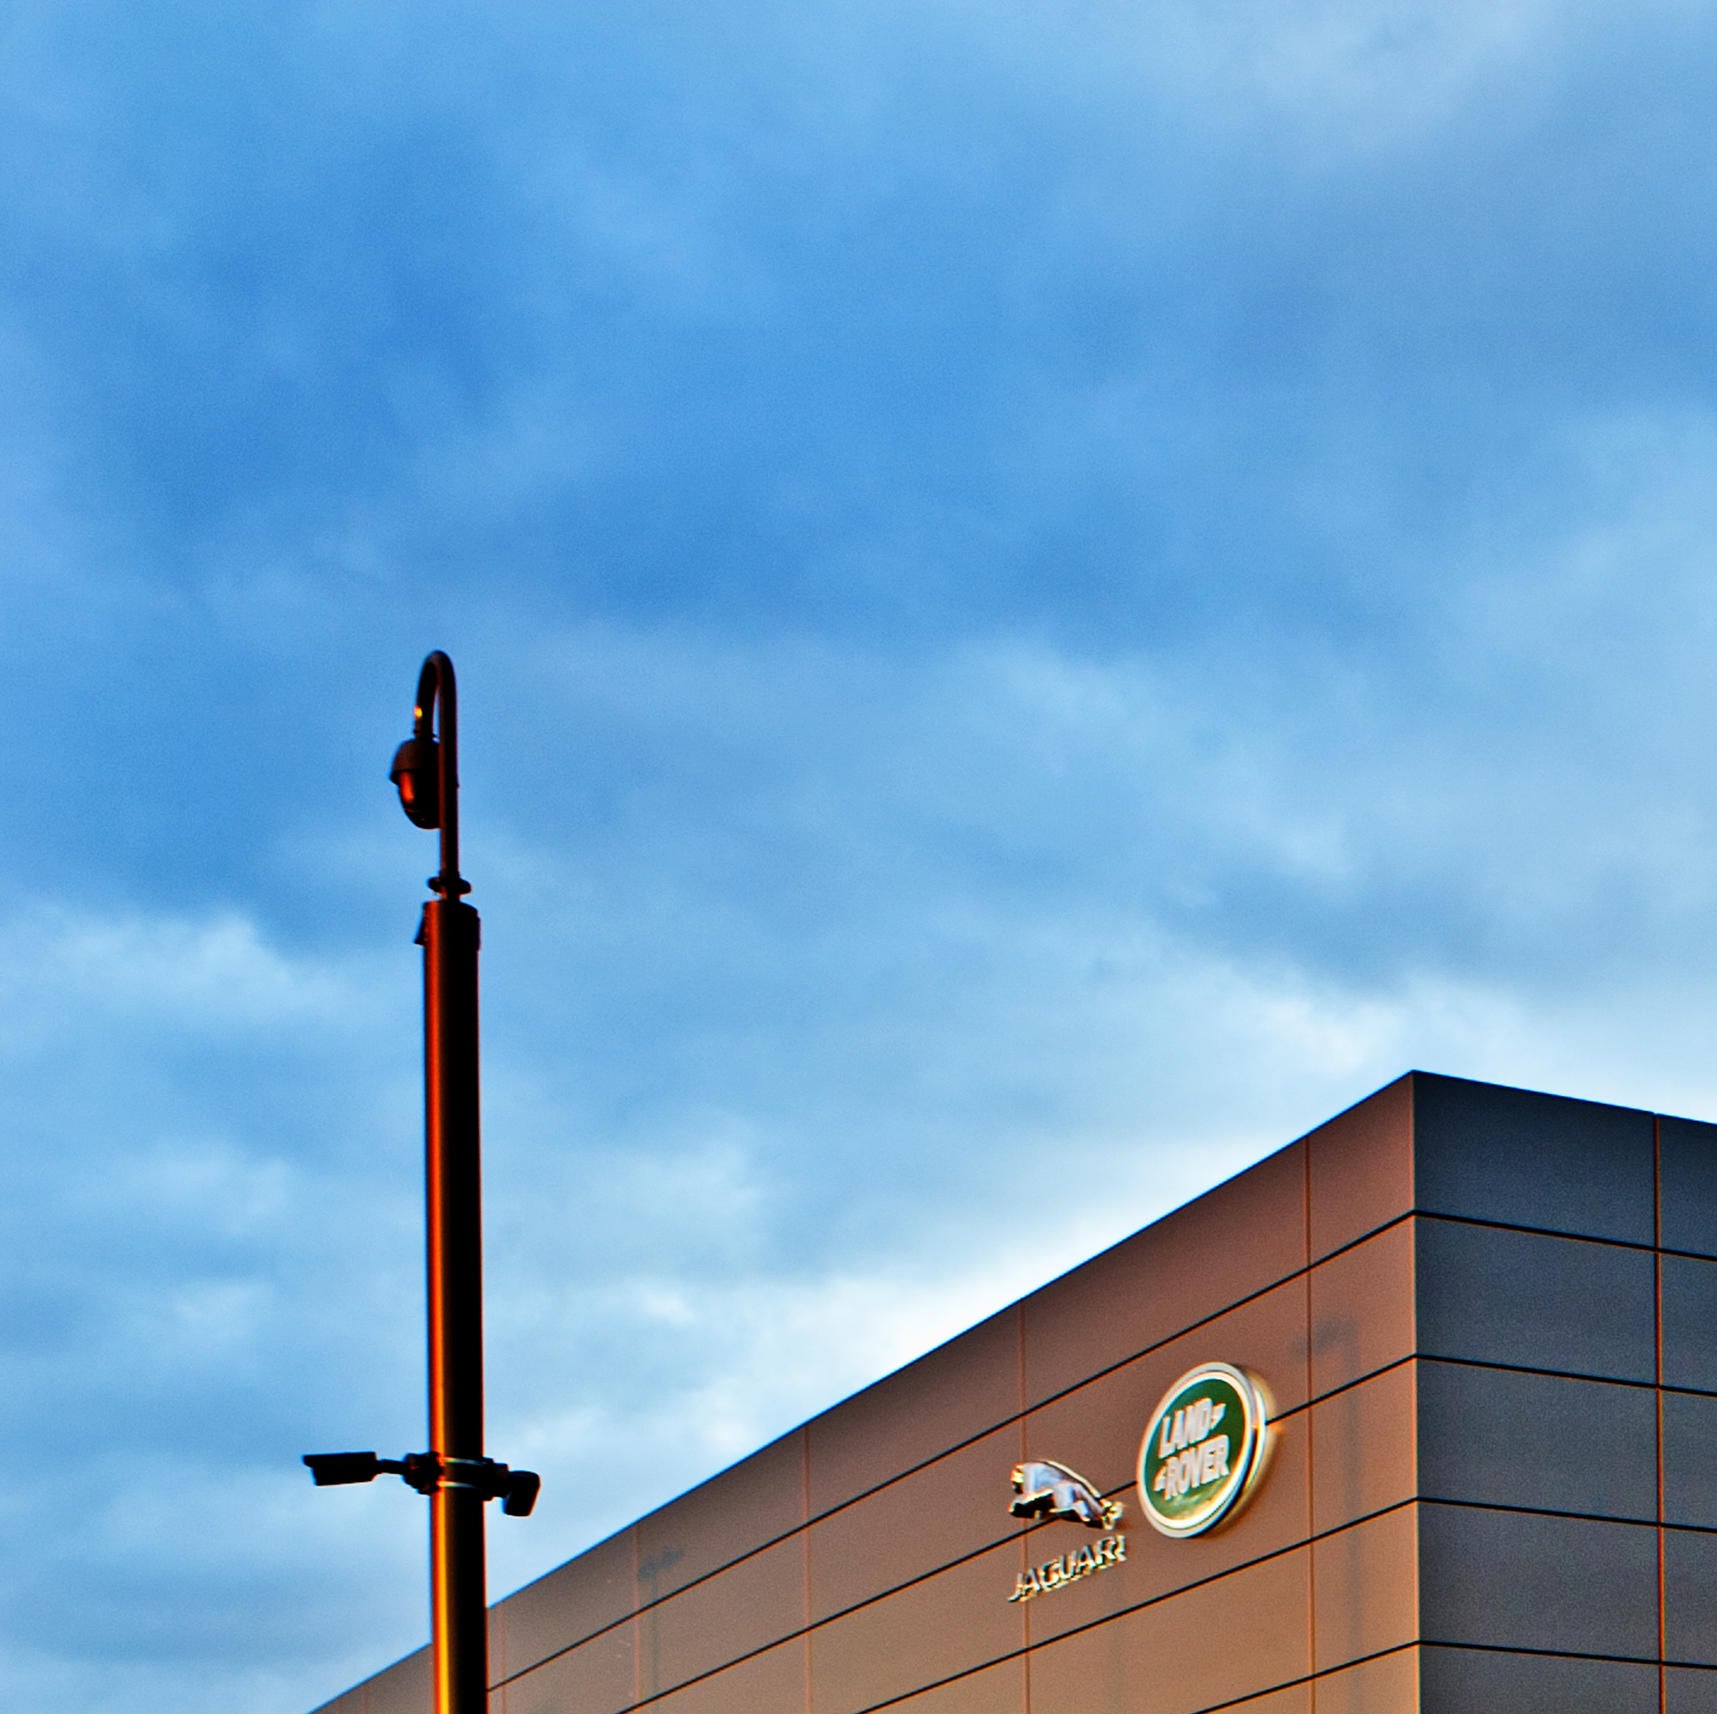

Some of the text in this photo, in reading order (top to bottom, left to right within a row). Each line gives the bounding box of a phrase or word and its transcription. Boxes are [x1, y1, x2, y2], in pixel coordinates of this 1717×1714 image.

[1158, 1397, 1213, 1459] LAND
[1163, 1434, 1229, 1500] ROVER
[1008, 1535, 1127, 1603] JAGUAR
